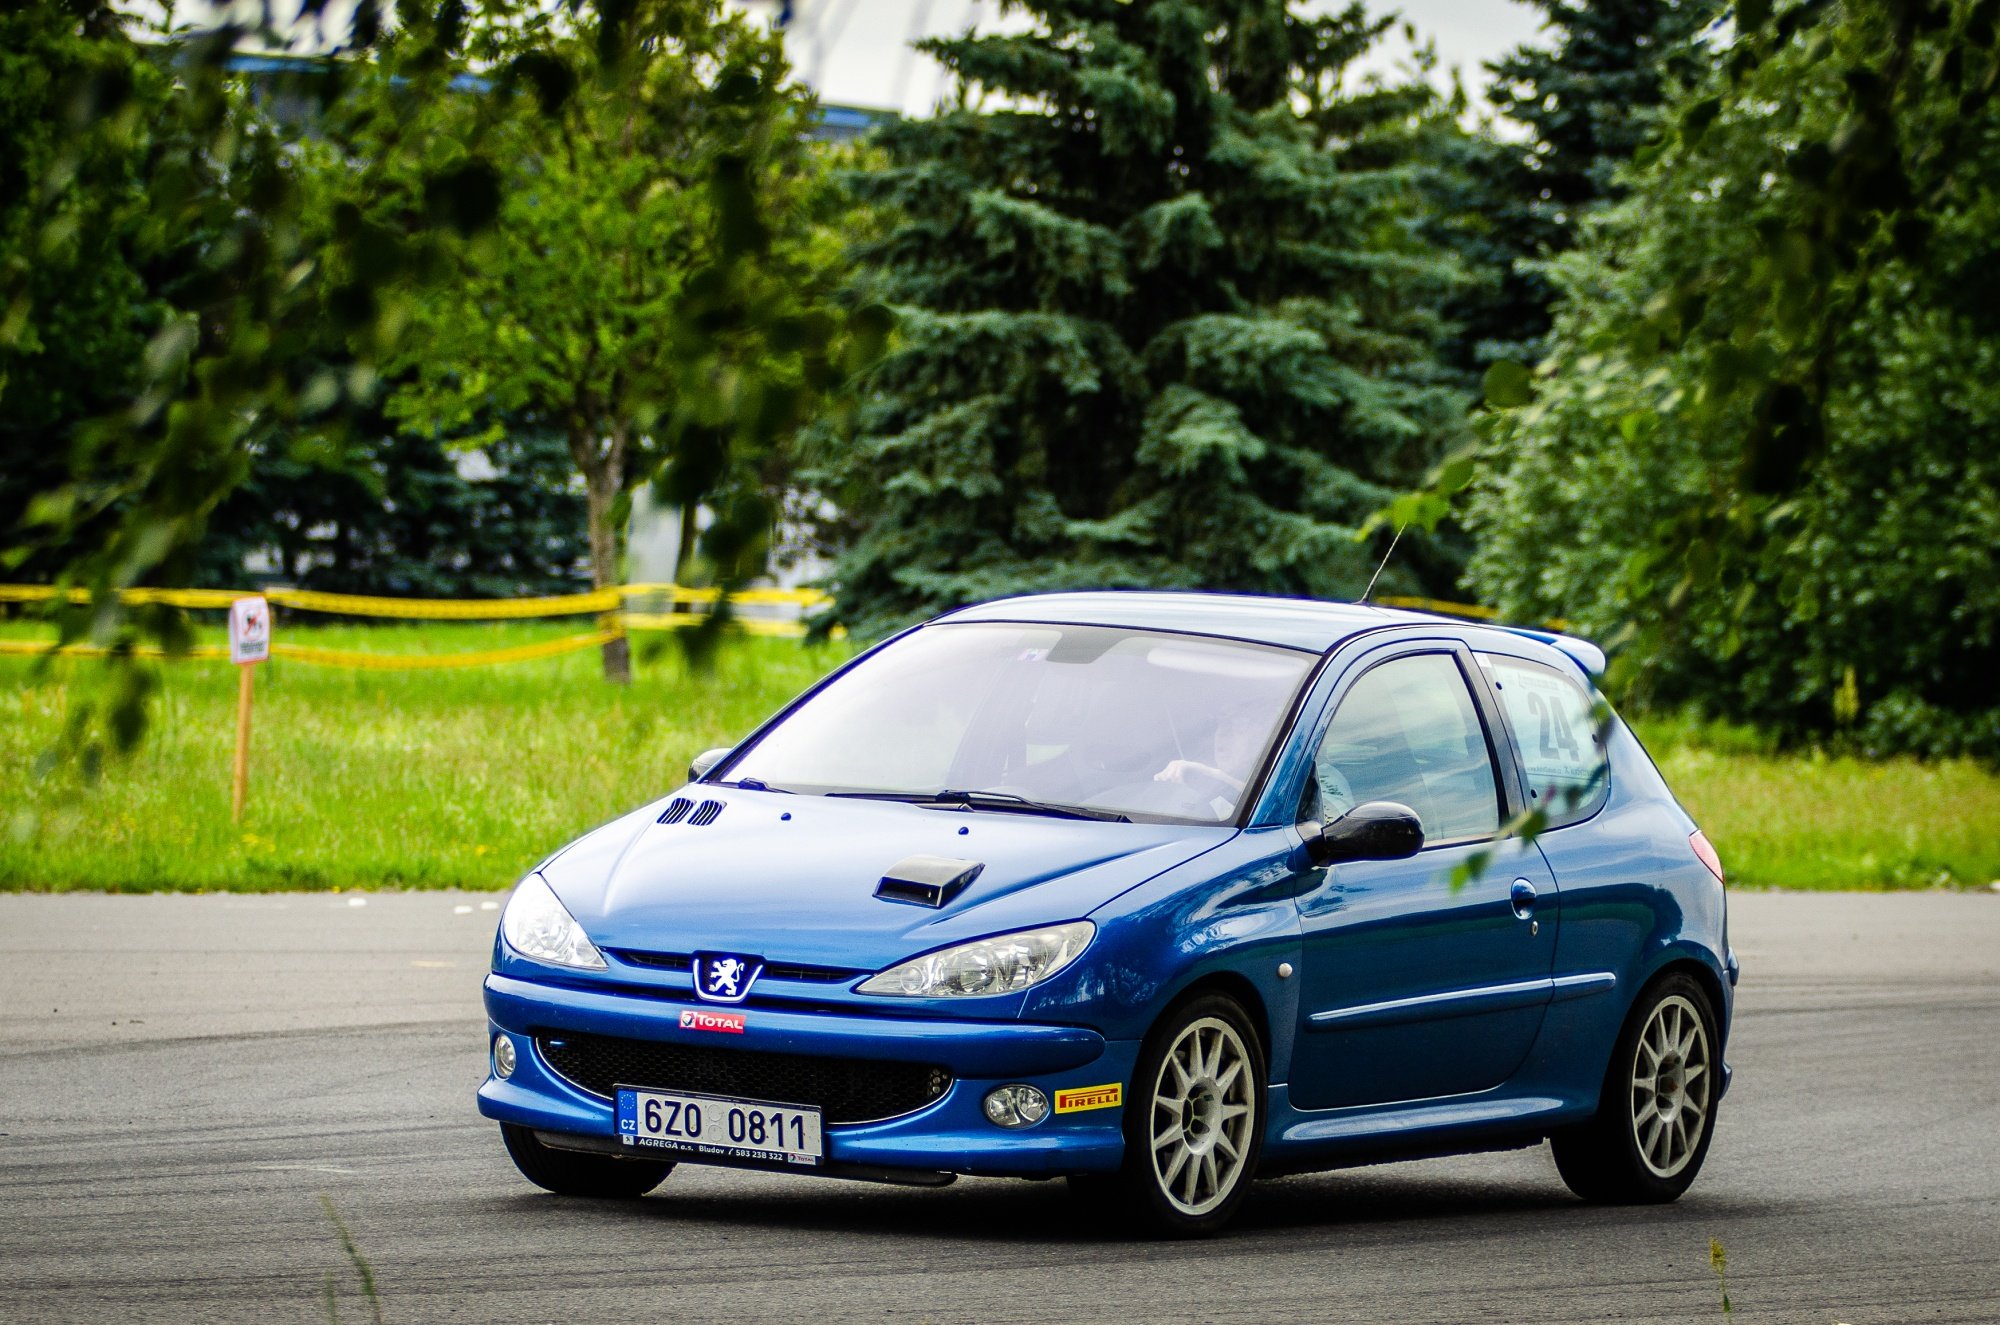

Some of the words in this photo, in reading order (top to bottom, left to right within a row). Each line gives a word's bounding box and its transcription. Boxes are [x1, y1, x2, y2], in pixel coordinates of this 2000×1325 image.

[1528, 692, 1579, 761] 24
[698, 1015, 743, 1030] TOTAL
[1060, 1088, 1118, 1108] PIRELLI
[621, 1119, 635, 1131] CZ
[645, 1099, 701, 1138] 6Z0
[728, 1108, 804, 1150] 0811
[639, 1138, 678, 1149] AGREGA
[698, 1145, 725, 1154] Bludov
[735, 1149, 751, 1158] 583
[768, 1152, 783, 1161] 322
